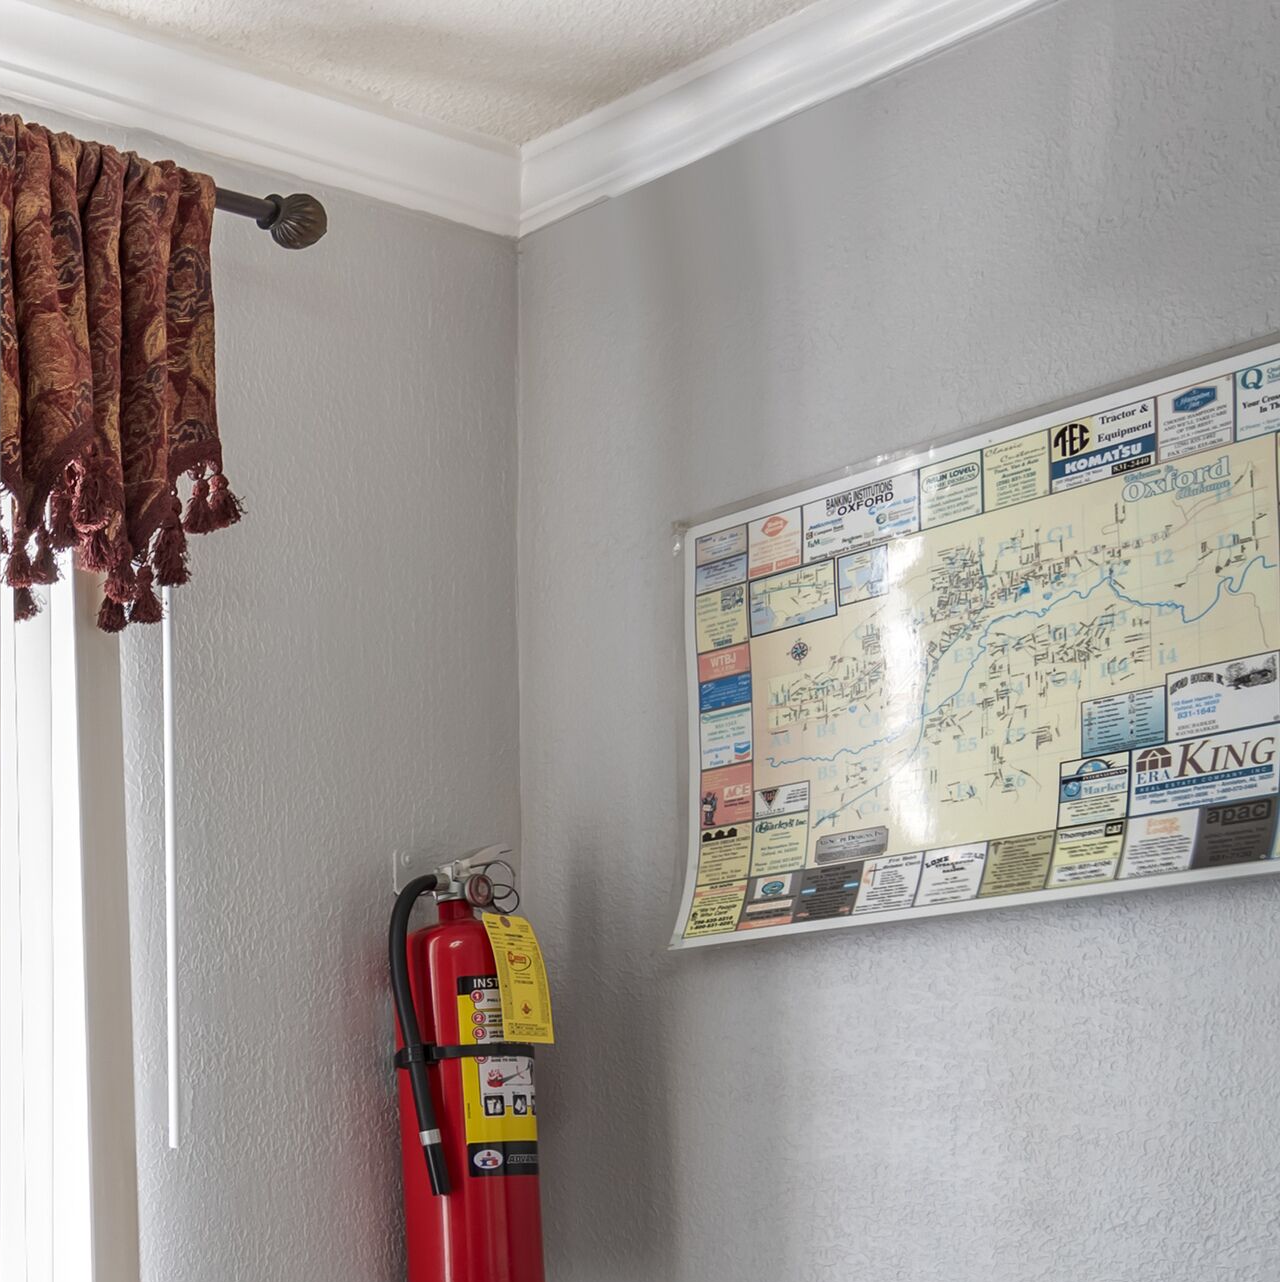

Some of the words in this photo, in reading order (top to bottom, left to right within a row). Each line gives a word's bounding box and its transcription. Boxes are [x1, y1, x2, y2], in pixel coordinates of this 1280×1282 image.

[1240, 368, 1264, 390] Q
[1099, 408, 1137, 425] Tractor
[1137, 404, 1148, 413] &
[1242, 400, 1260, 409] Your
[1053, 423, 1090, 457] TEC
[1097, 420, 1152, 443] Equipment
[1065, 443, 1142, 474] KOMATSU
[1112, 456, 1150, 473] 831-2440
[949, 465, 976, 478] LOVELL
[1122, 455, 1231, 502] Oxford
[826, 493, 852, 510] BANKING
[853, 480, 893, 500] INSTITUTIONS
[837, 492, 894, 516] OXFORD
[710, 652, 737, 668] WTBJ
[1137, 769, 1171, 785] ERA
[1173, 737, 1276, 778] KING
[724, 783, 751, 798] ACE
[1083, 782, 1126, 796] Market
[1139, 784, 1161, 793] REAL
[1165, 779, 1196, 789] ESTATE
[1207, 802, 1266, 824] apac
[1059, 827, 1103, 840] Thompson
